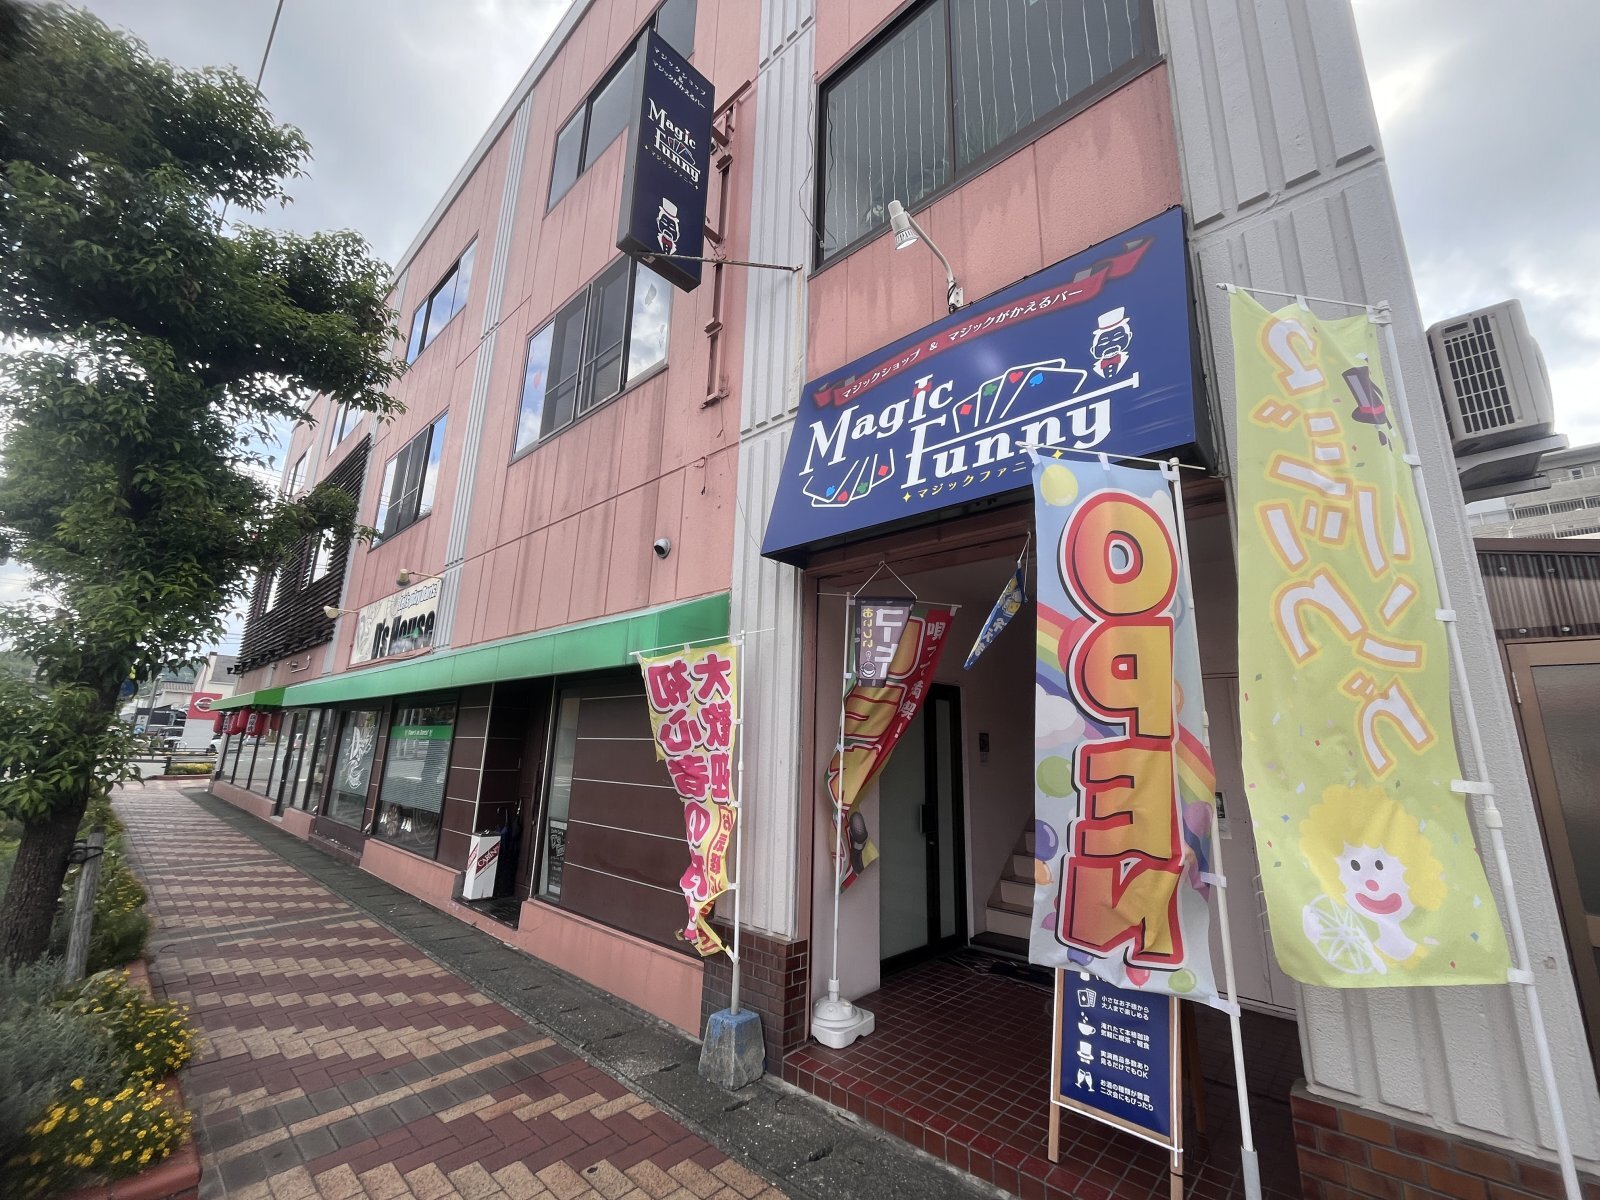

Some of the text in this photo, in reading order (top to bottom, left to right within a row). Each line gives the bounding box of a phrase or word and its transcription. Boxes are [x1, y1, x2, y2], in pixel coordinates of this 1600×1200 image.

[647, 97, 696, 149] Magic
[654, 127, 701, 183] Funny
[841, 288, 1084, 399] マジックショップ & マジックがかえるバー
[798, 374, 954, 476] Magic
[901, 372, 1140, 489] Funny
[917, 461, 1028, 498] マジックファニ
[1101, 995, 1150, 1014] 小さなお子様から
[1101, 1002, 1149, 1021] 大人まで楽しめる
[1101, 1057, 1149, 1079] 見るだけでもOK
